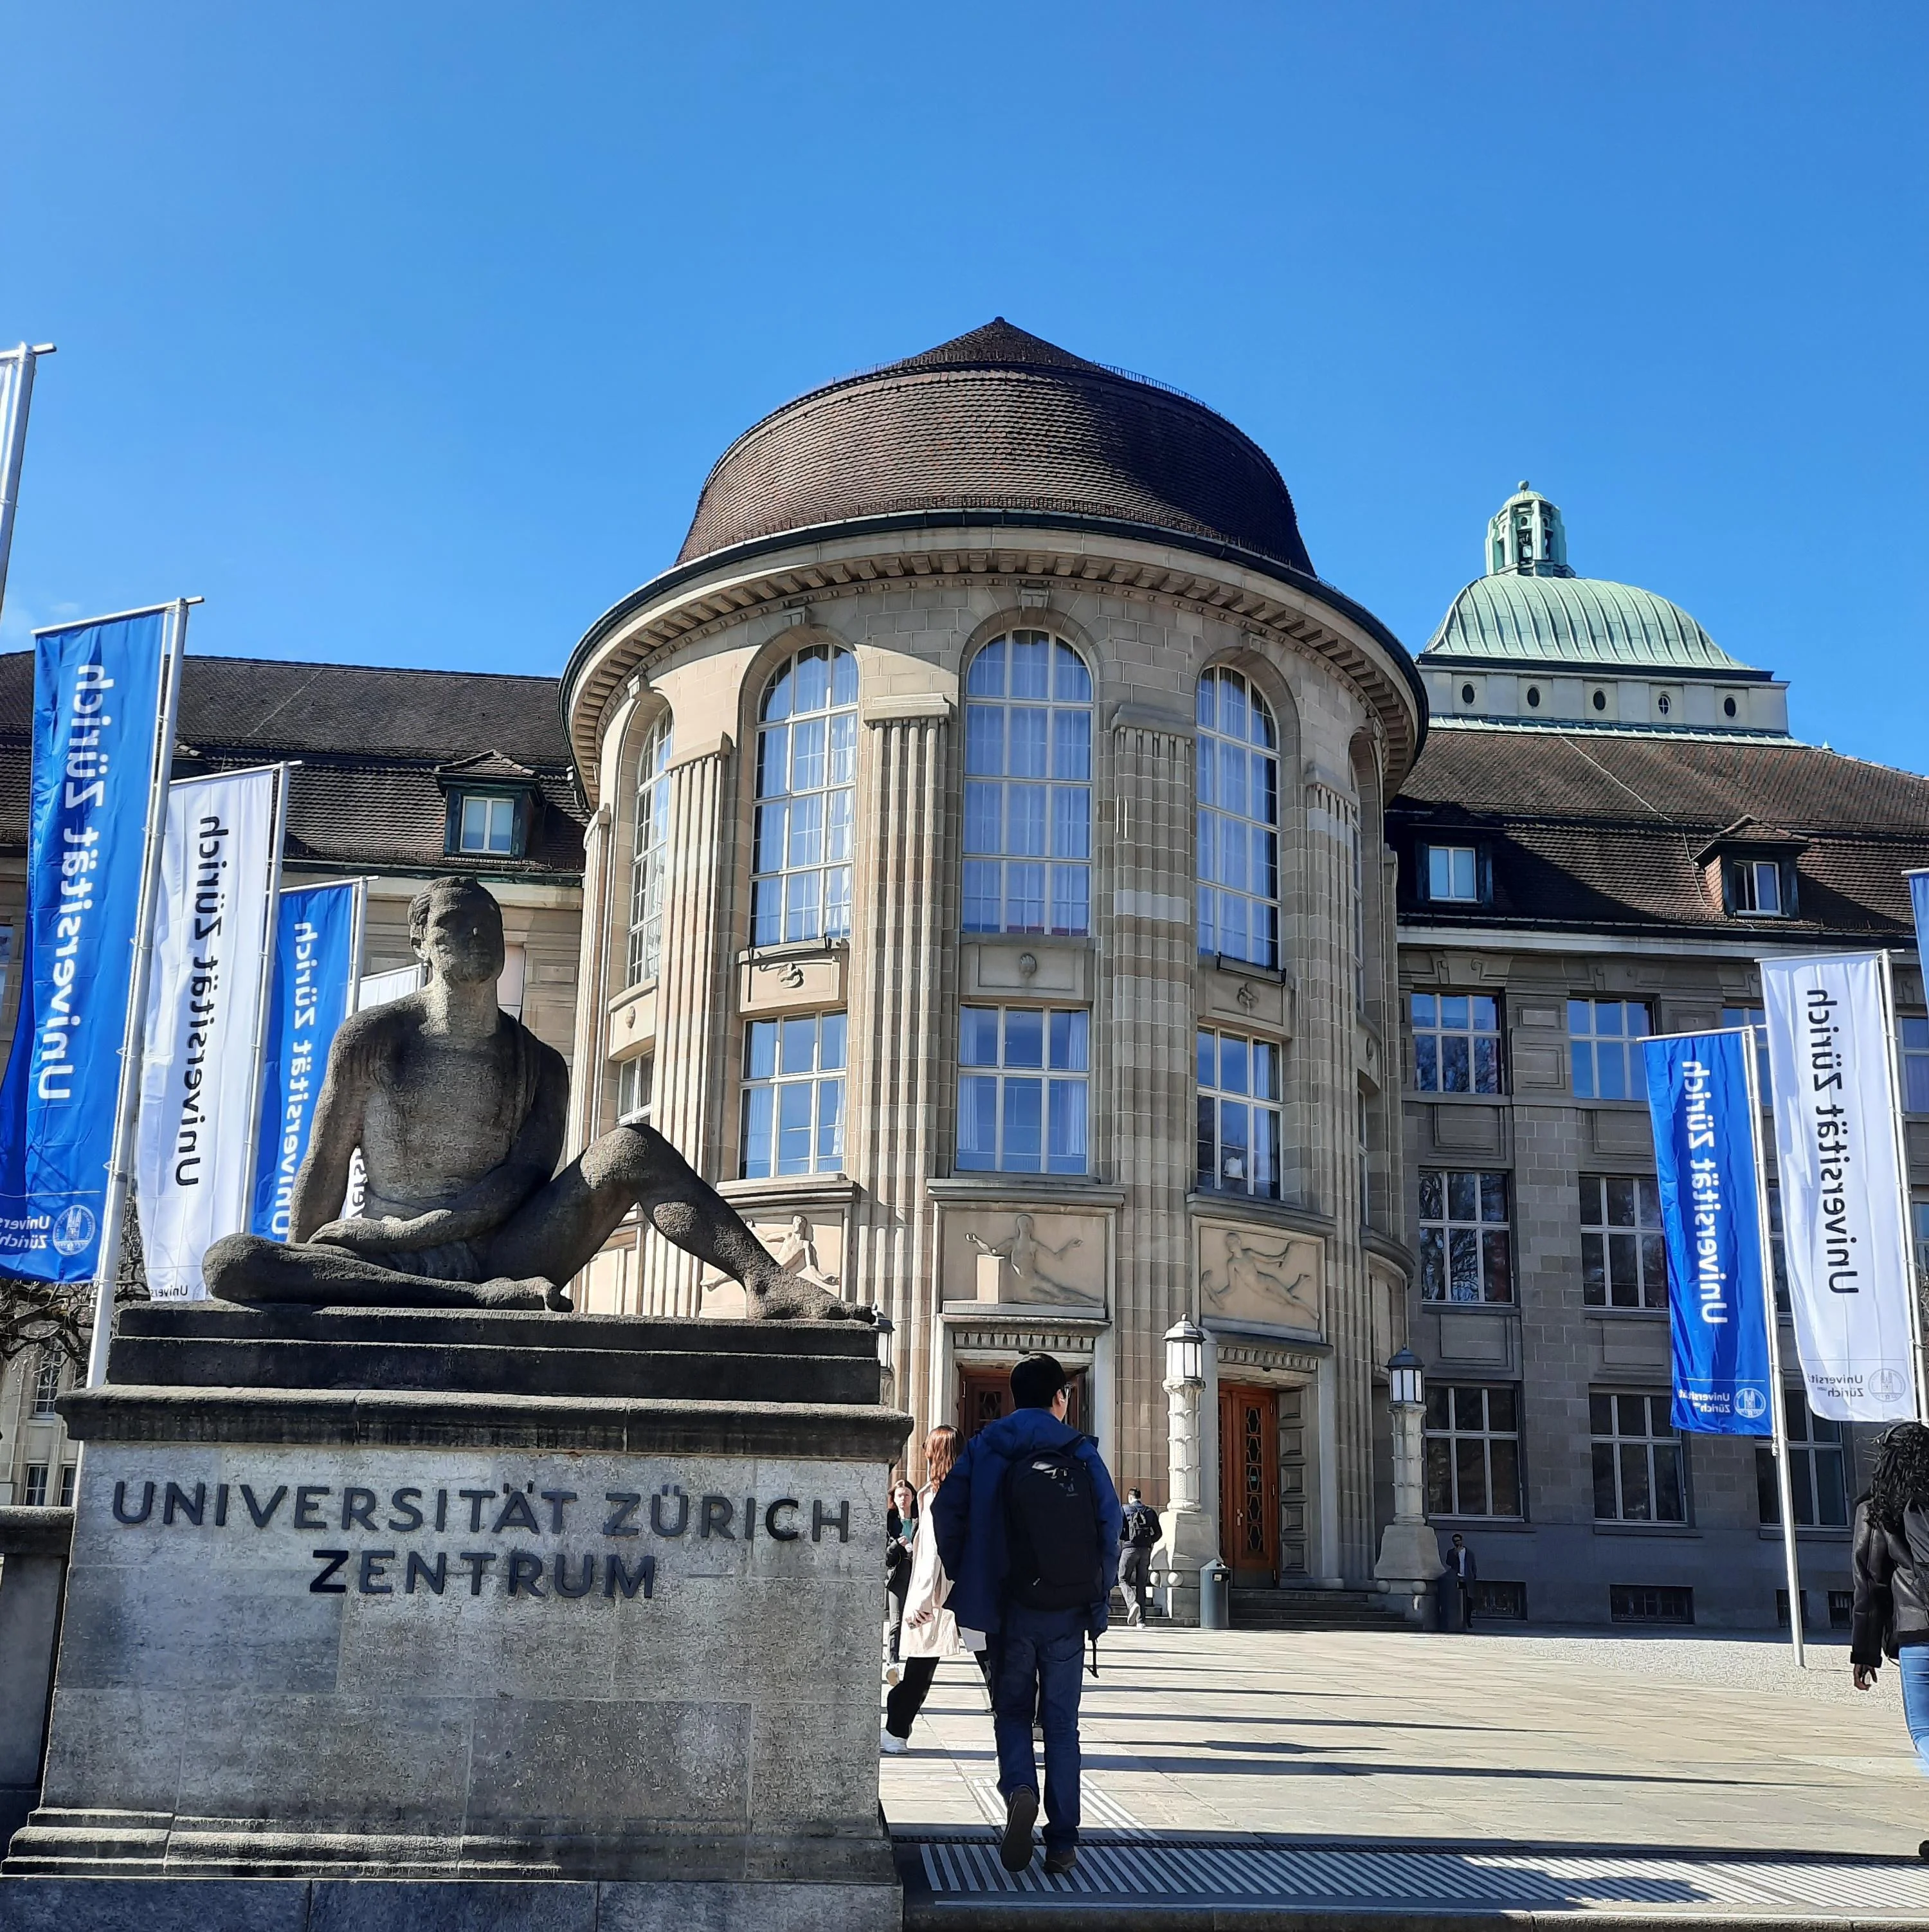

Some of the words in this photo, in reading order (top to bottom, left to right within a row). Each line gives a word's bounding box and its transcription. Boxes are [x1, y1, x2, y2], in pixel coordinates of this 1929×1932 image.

[112, 1480, 577, 1535] UNIVERSITÄT
[602, 1484, 850, 1543] ZÜRICH
[309, 1549, 655, 1599] ZENTRUM
